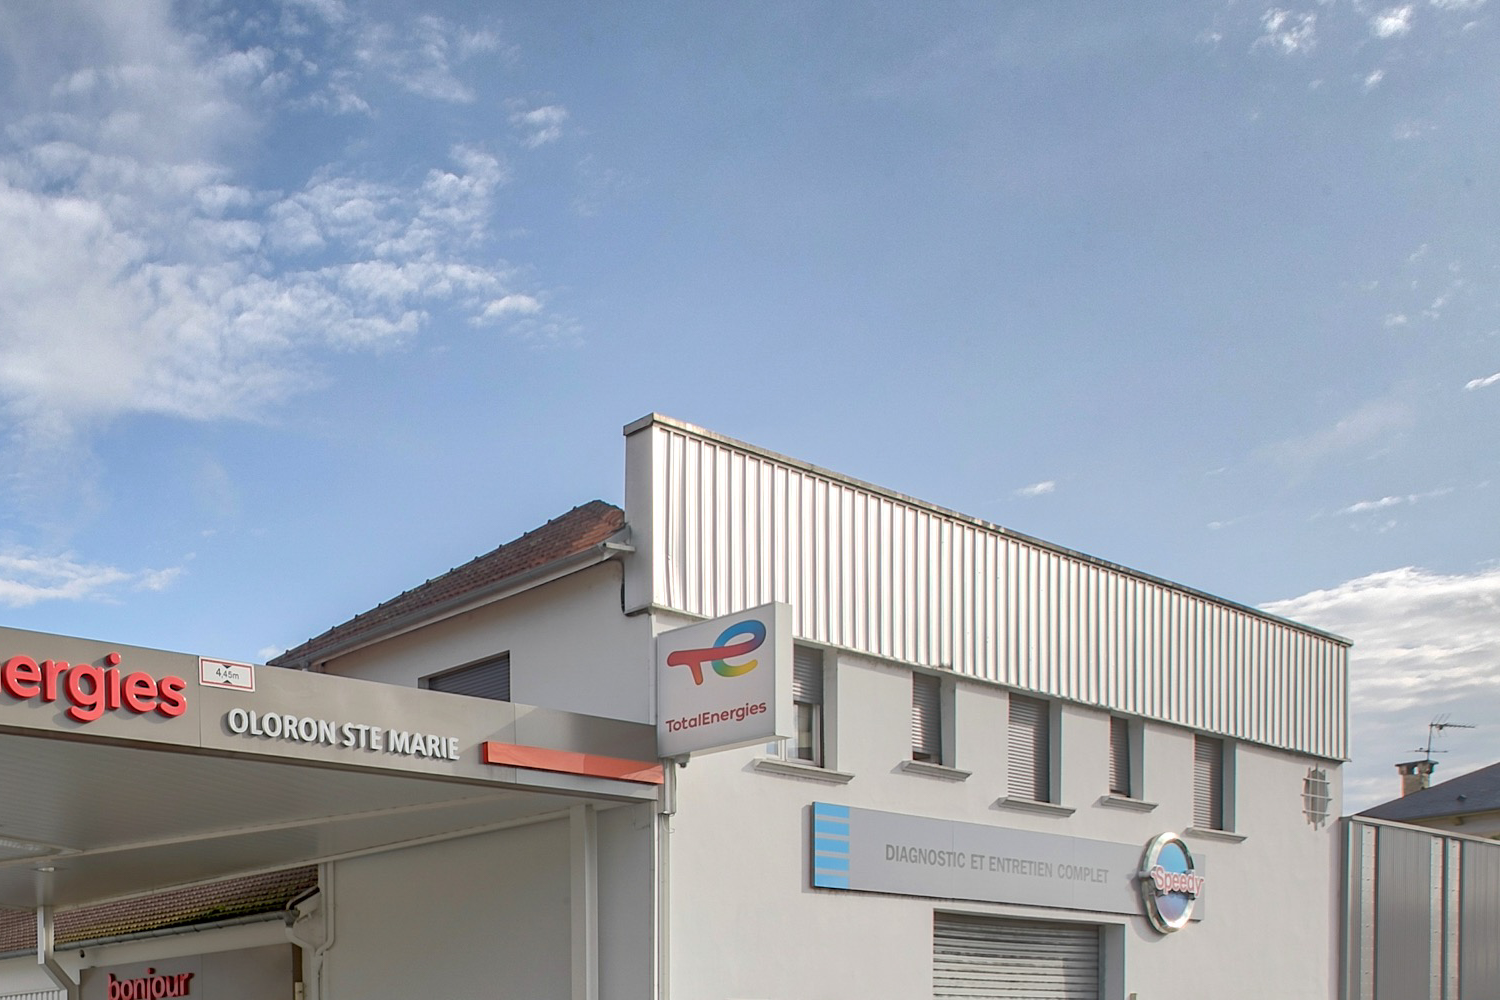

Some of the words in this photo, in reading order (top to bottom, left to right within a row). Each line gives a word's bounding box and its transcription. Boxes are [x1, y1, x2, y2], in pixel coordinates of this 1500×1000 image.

[215, 667, 240, 680] 4,45m
[665, 702, 767, 732] TotalEnergies
[227, 708, 336, 745] OLORON
[341, 722, 384, 750] STE
[388, 729, 461, 760] MARIE
[885, 844, 966, 868] DIAGNOSTIC
[971, 856, 985, 871] ET
[988, 856, 1053, 878] ENTRETIEN
[1057, 863, 1110, 884] COMPLET
[1152, 866, 1204, 896] Speedy
